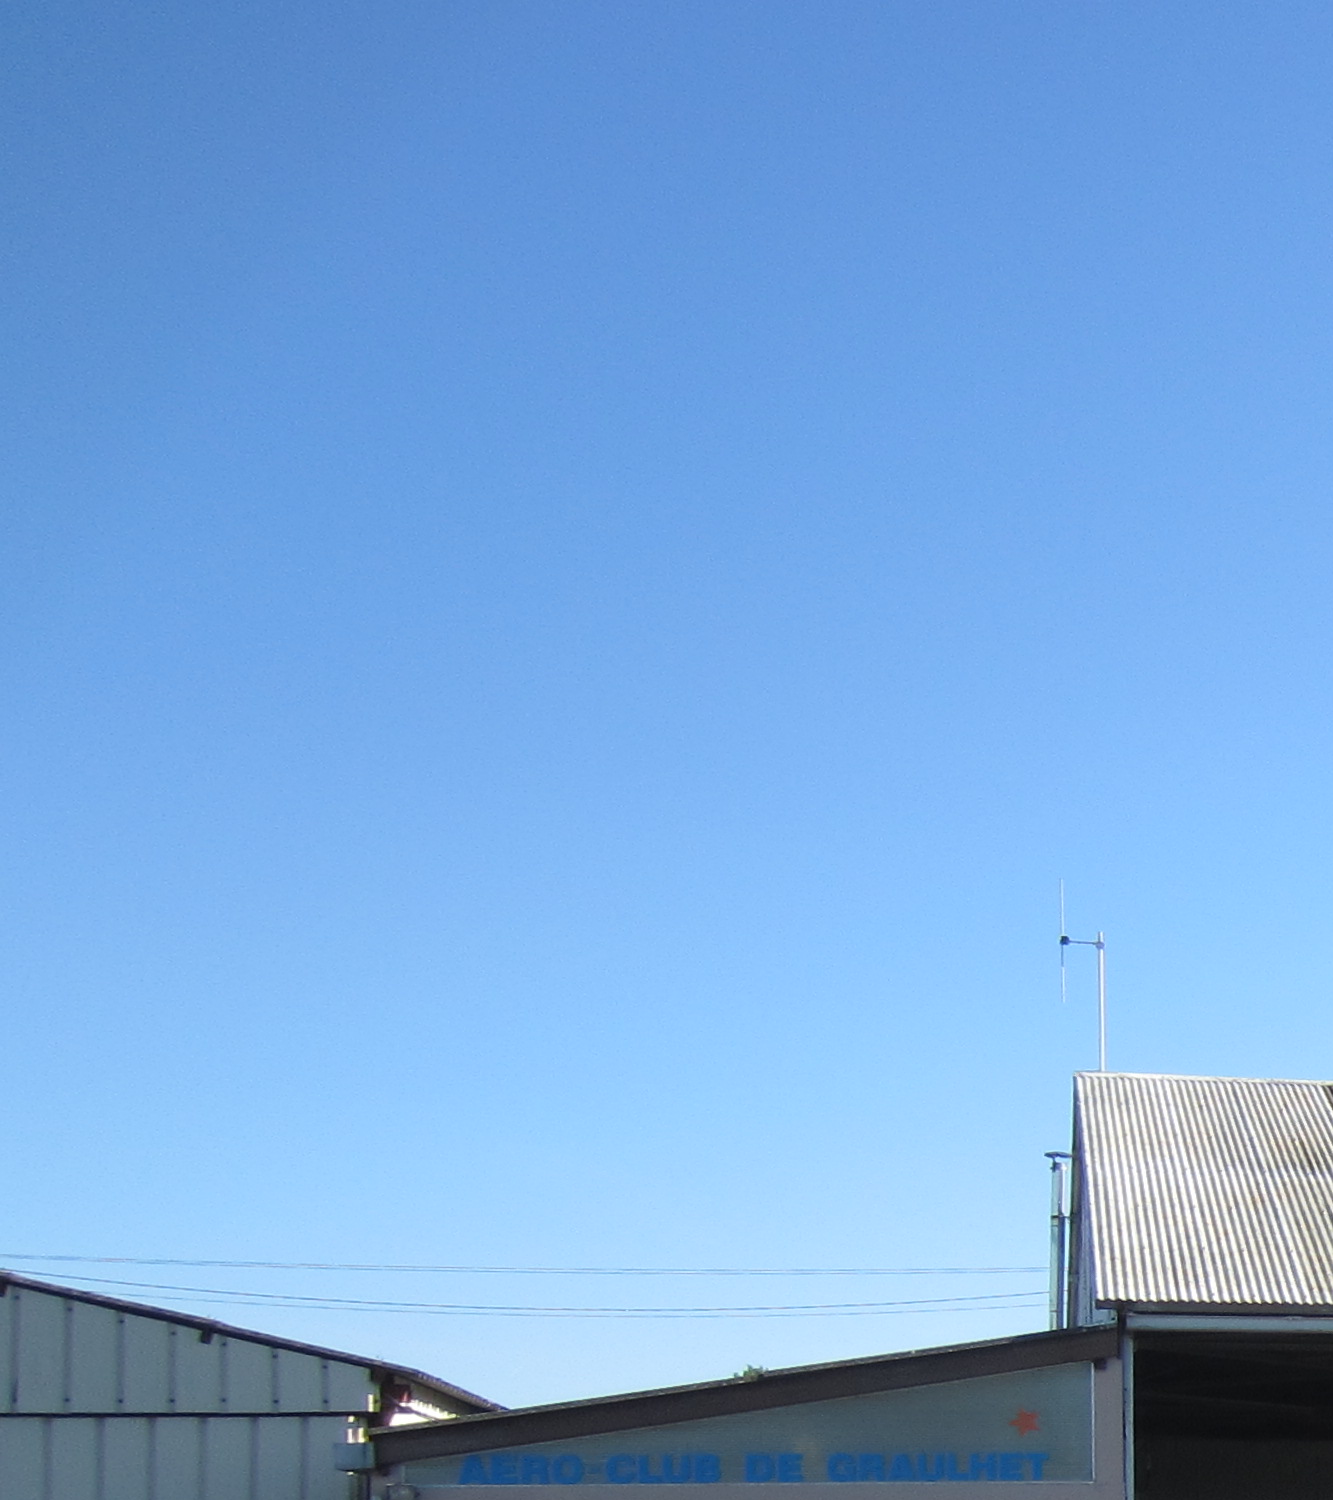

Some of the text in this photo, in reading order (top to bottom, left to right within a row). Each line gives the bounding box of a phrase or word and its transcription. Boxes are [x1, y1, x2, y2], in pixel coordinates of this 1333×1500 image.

[458, 1452, 1049, 1485] AERO-CLUB DE GRAULHET
